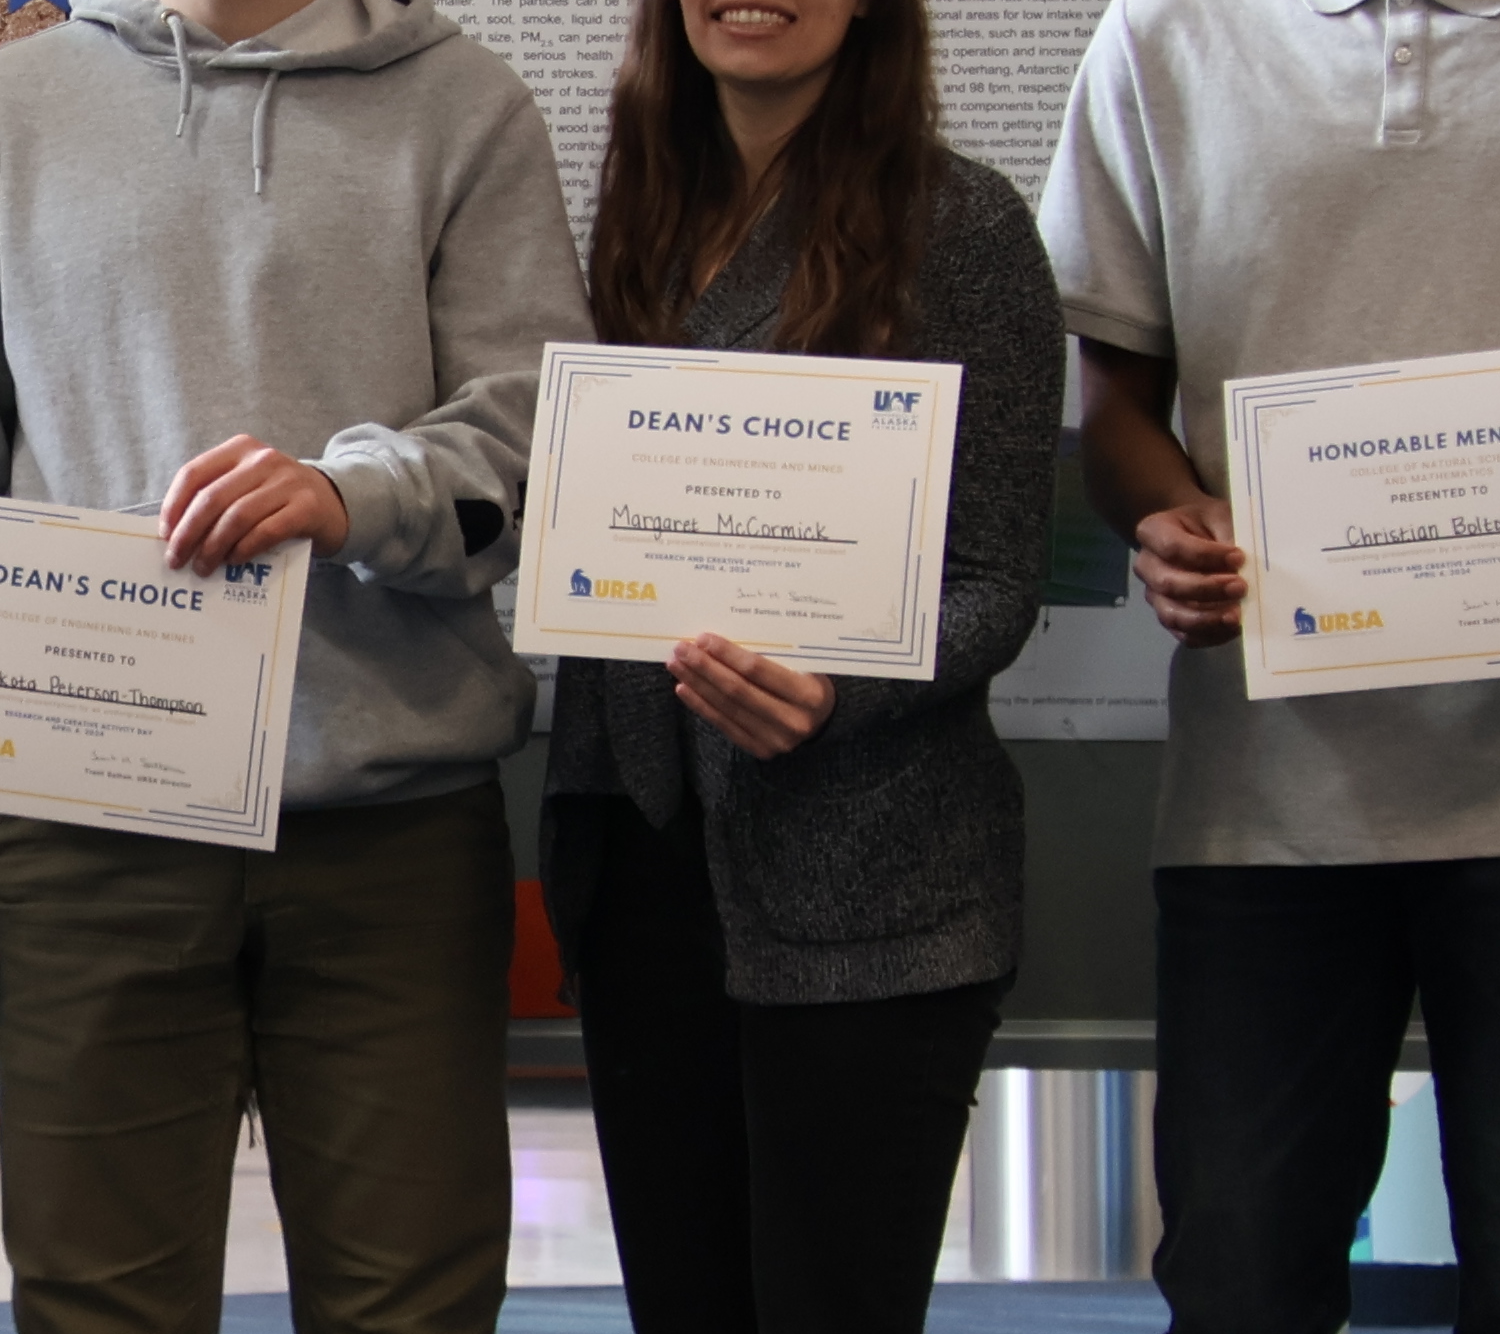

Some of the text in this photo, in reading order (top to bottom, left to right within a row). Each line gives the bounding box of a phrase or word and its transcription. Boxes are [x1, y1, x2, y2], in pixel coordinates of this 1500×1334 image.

[874, 391, 920, 412] UAF
[628, 410, 850, 441] DEAN'S CHOICE
[1309, 433, 1446, 462] HONORABLE
[685, 485, 781, 499] PRESENTED TO
[1391, 486, 1488, 503] PRESENTED TO
[612, 505, 828, 541] Margaret McCormick
[1346, 524, 1439, 547] Christian
[101, 580, 203, 611] CHOICE
[596, 581, 656, 599] URSA
[1320, 611, 1383, 632] URSA
[45, 645, 135, 666] PRESENTED TO
[49, 674, 205, 715] Peterson-Thompson
